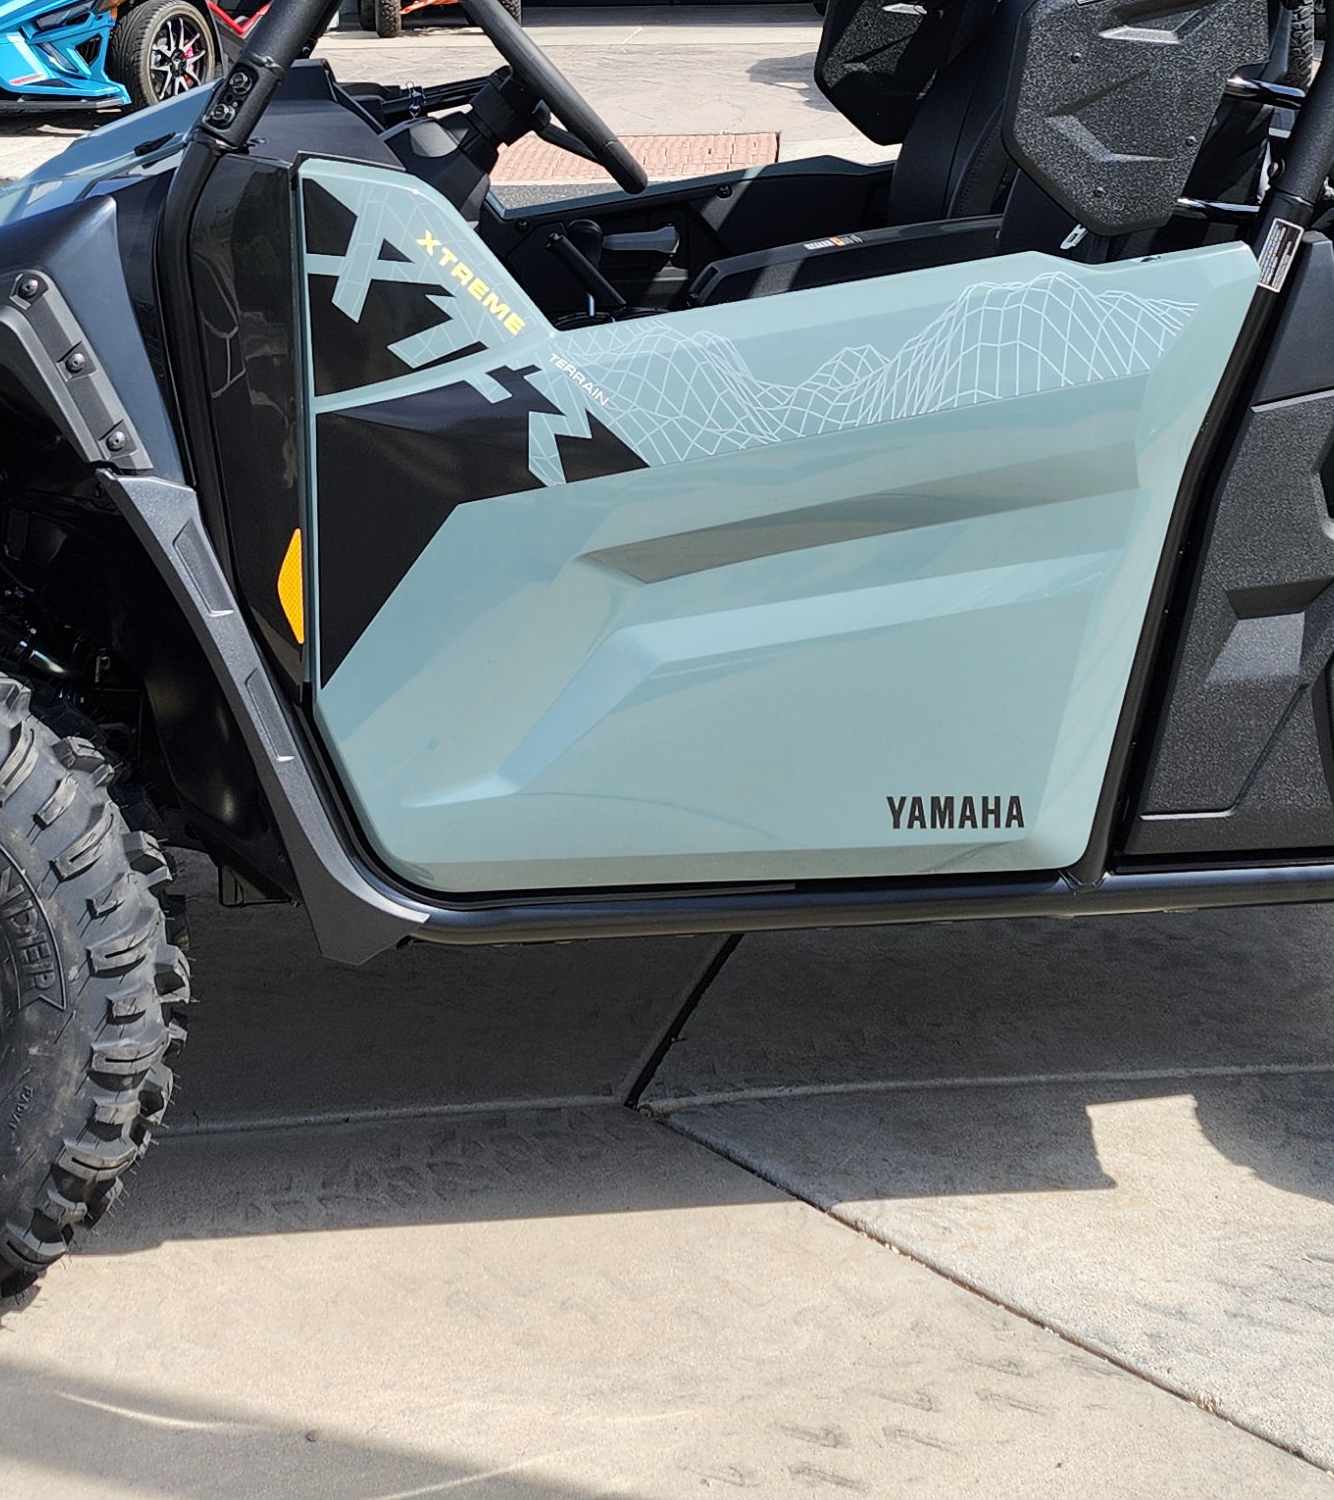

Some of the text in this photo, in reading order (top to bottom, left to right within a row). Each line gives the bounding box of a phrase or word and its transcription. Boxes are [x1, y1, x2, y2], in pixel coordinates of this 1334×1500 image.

[416, 229, 526, 335] XTREME
[549, 353, 609, 407] TERRAIN
[886, 795, 1025, 830] YAMAHA
